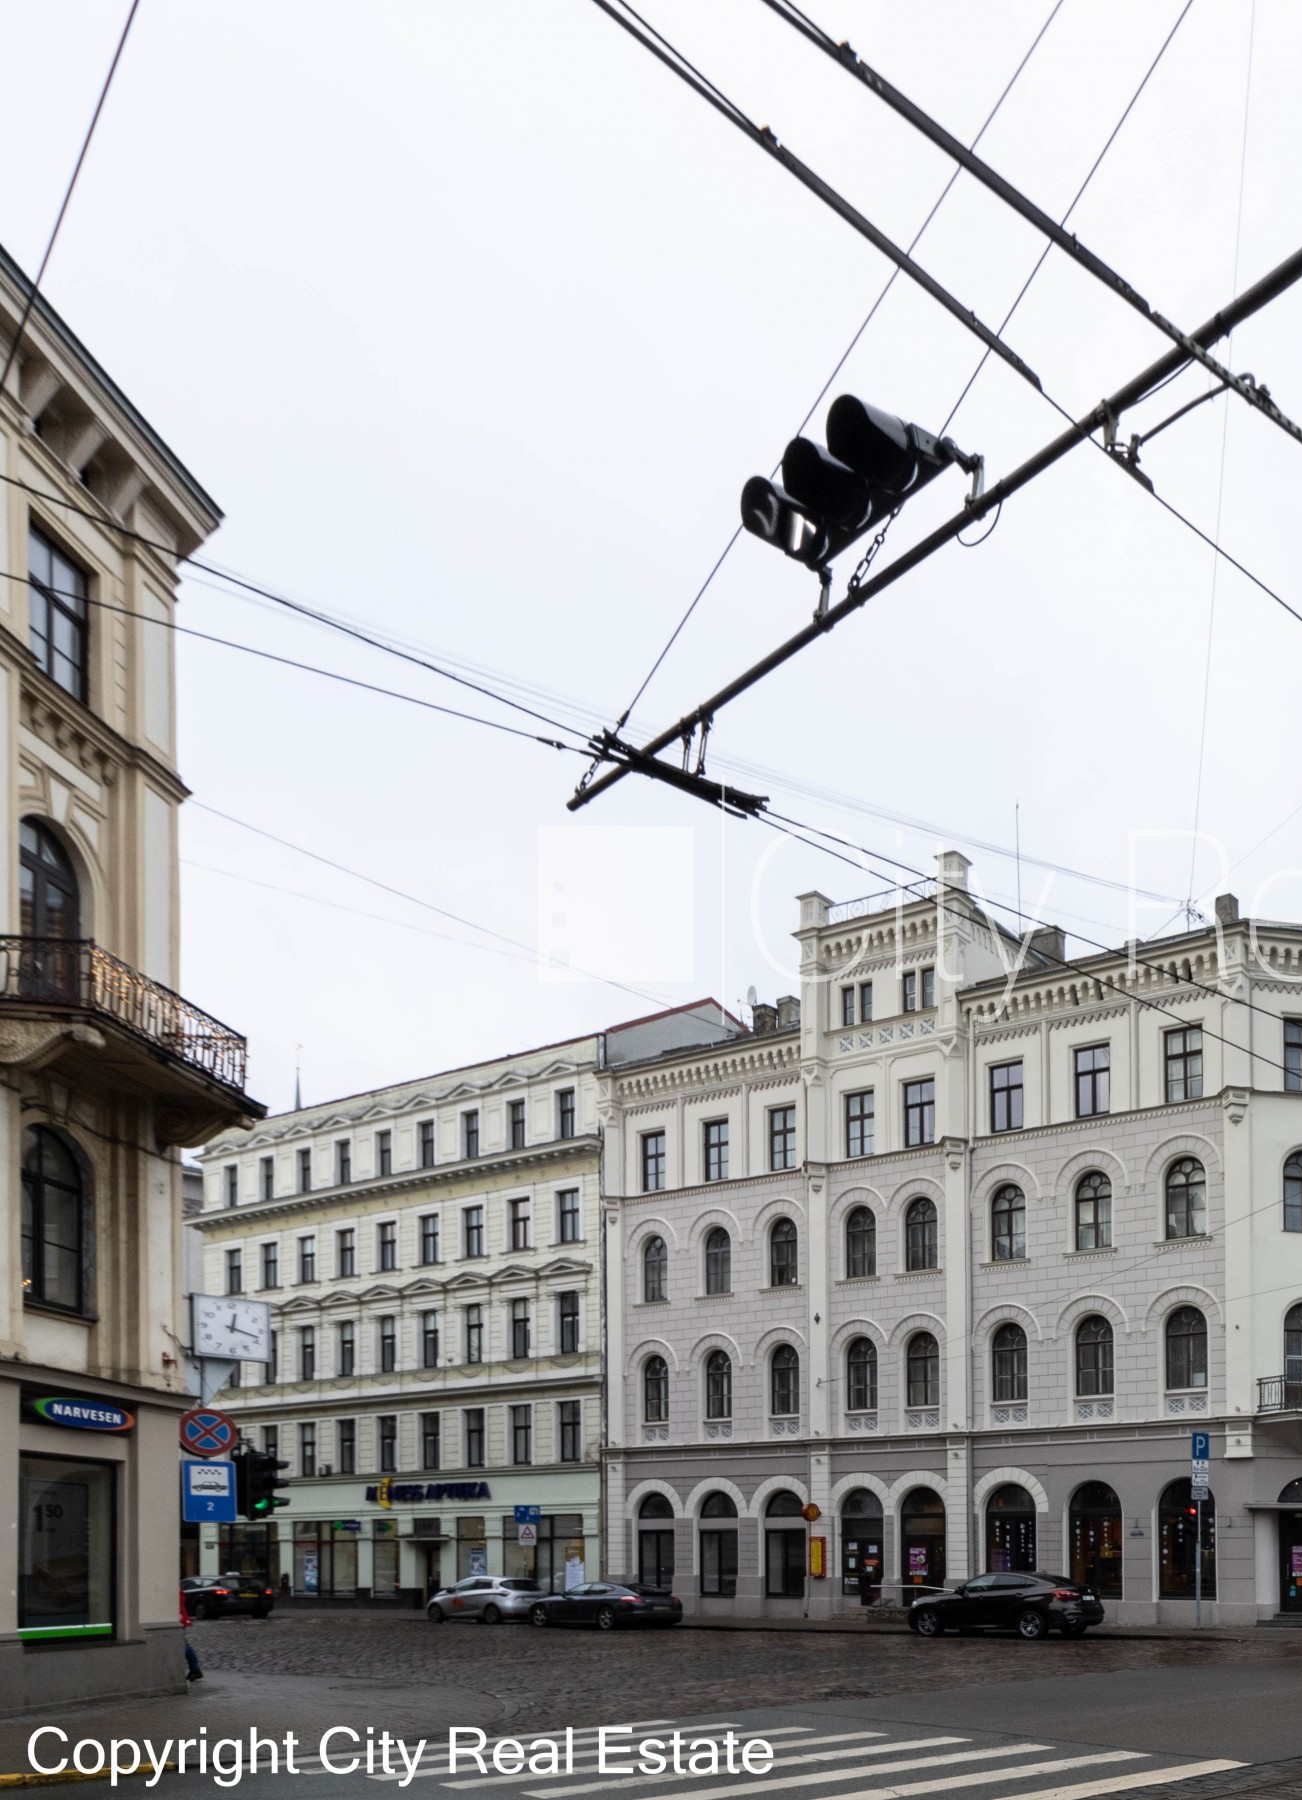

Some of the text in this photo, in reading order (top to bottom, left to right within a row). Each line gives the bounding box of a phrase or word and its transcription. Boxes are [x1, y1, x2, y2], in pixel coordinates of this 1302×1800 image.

[52, 1403, 122, 1425] NARVESEN
[1196, 1435, 1206, 1457] P
[206, 1502, 215, 1511] 2
